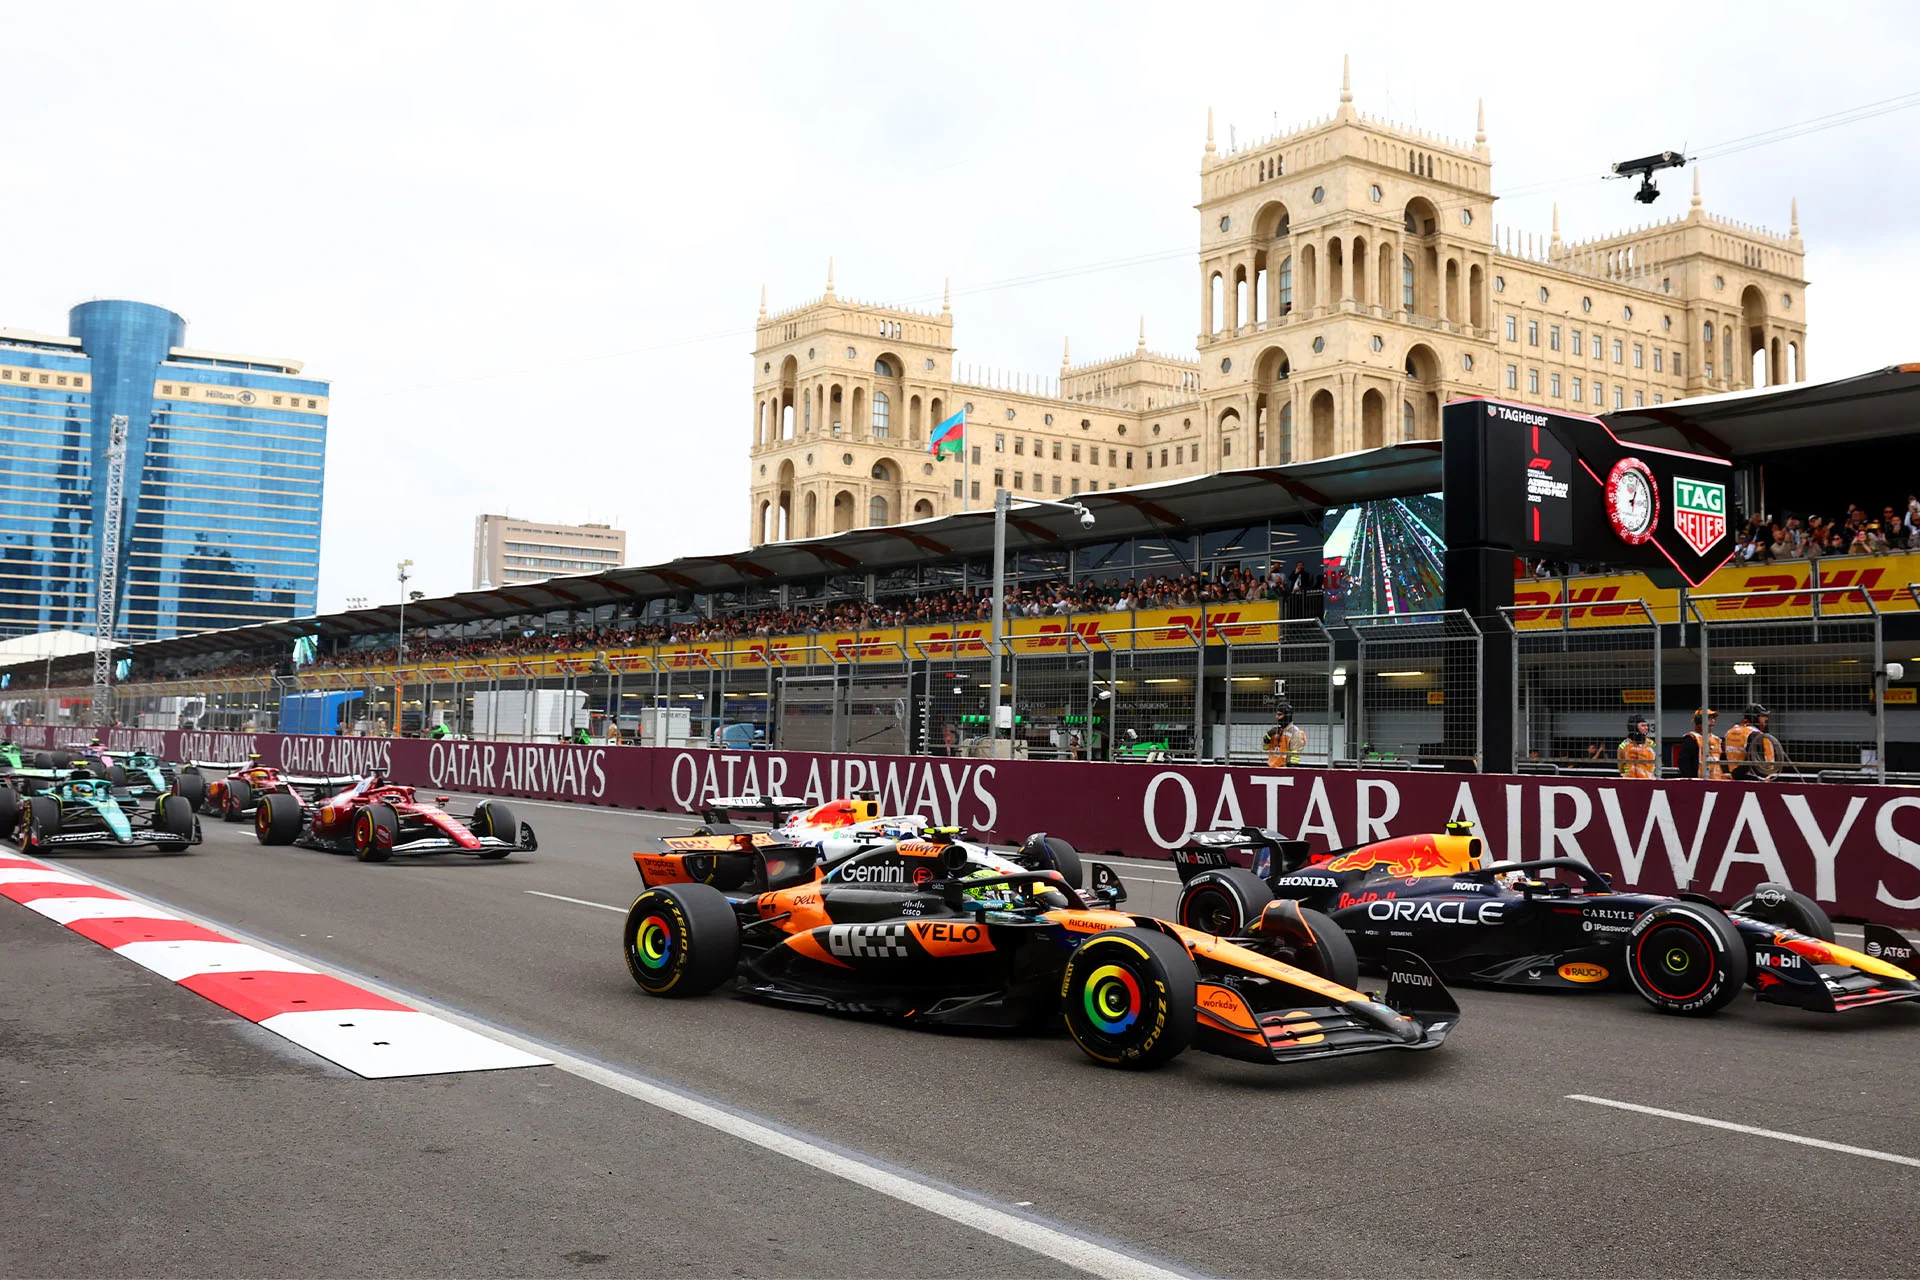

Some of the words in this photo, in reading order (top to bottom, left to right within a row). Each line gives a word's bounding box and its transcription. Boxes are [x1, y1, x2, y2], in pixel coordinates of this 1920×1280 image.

[206, 390, 235, 401] Hilton
[1678, 483, 1721, 511] TAG
[1678, 512, 1724, 551] HEUER
[1744, 568, 1894, 608] DHL
[1515, 586, 1628, 621] DHL
[1038, 621, 1103, 647] DHL
[1166, 611, 1247, 640] DHL
[834, 636, 883, 659] DHL
[928, 629, 986, 654] DHL
[673, 648, 709, 667] DHL
[748, 643, 791, 663] DHL
[180, 733, 212, 762] QATAR
[212, 734, 257, 765] AIRWAYS
[280, 736, 324, 772] QATAR
[327, 739, 391, 778] AIRWAYS
[429, 742, 497, 788] QATAR
[501, 745, 606, 798] AIRWAYS
[671, 751, 789, 812] QATAR
[804, 758, 999, 833] AIRWAYS
[900, 842, 941, 855] allwyn
[1143, 771, 1401, 855] QATAR
[1447, 781, 1920, 910] AIRWAYS
[1176, 851, 1213, 865] Mobil
[841, 860, 905, 883] Gemini
[1278, 876, 1339, 888] HONDA
[1452, 882, 1484, 892] ROKT
[793, 894, 816, 906] DELL
[1368, 901, 1506, 926] ORACLE
[1582, 908, 1635, 920] CARLYLE
[915, 922, 981, 944] VELO
[1068, 919, 1107, 931] RICHARD
[1594, 923, 1631, 933] 1Passwor
[828, 925, 909, 958] OKX
[1883, 946, 1912, 959] AT&T
[1756, 951, 1801, 969] Mobil
[1571, 967, 1603, 977] RAUCH
[1154, 979, 1166, 994] P
[1203, 999, 1239, 1012] workday
[1143, 998, 1167, 1052] ZERO
